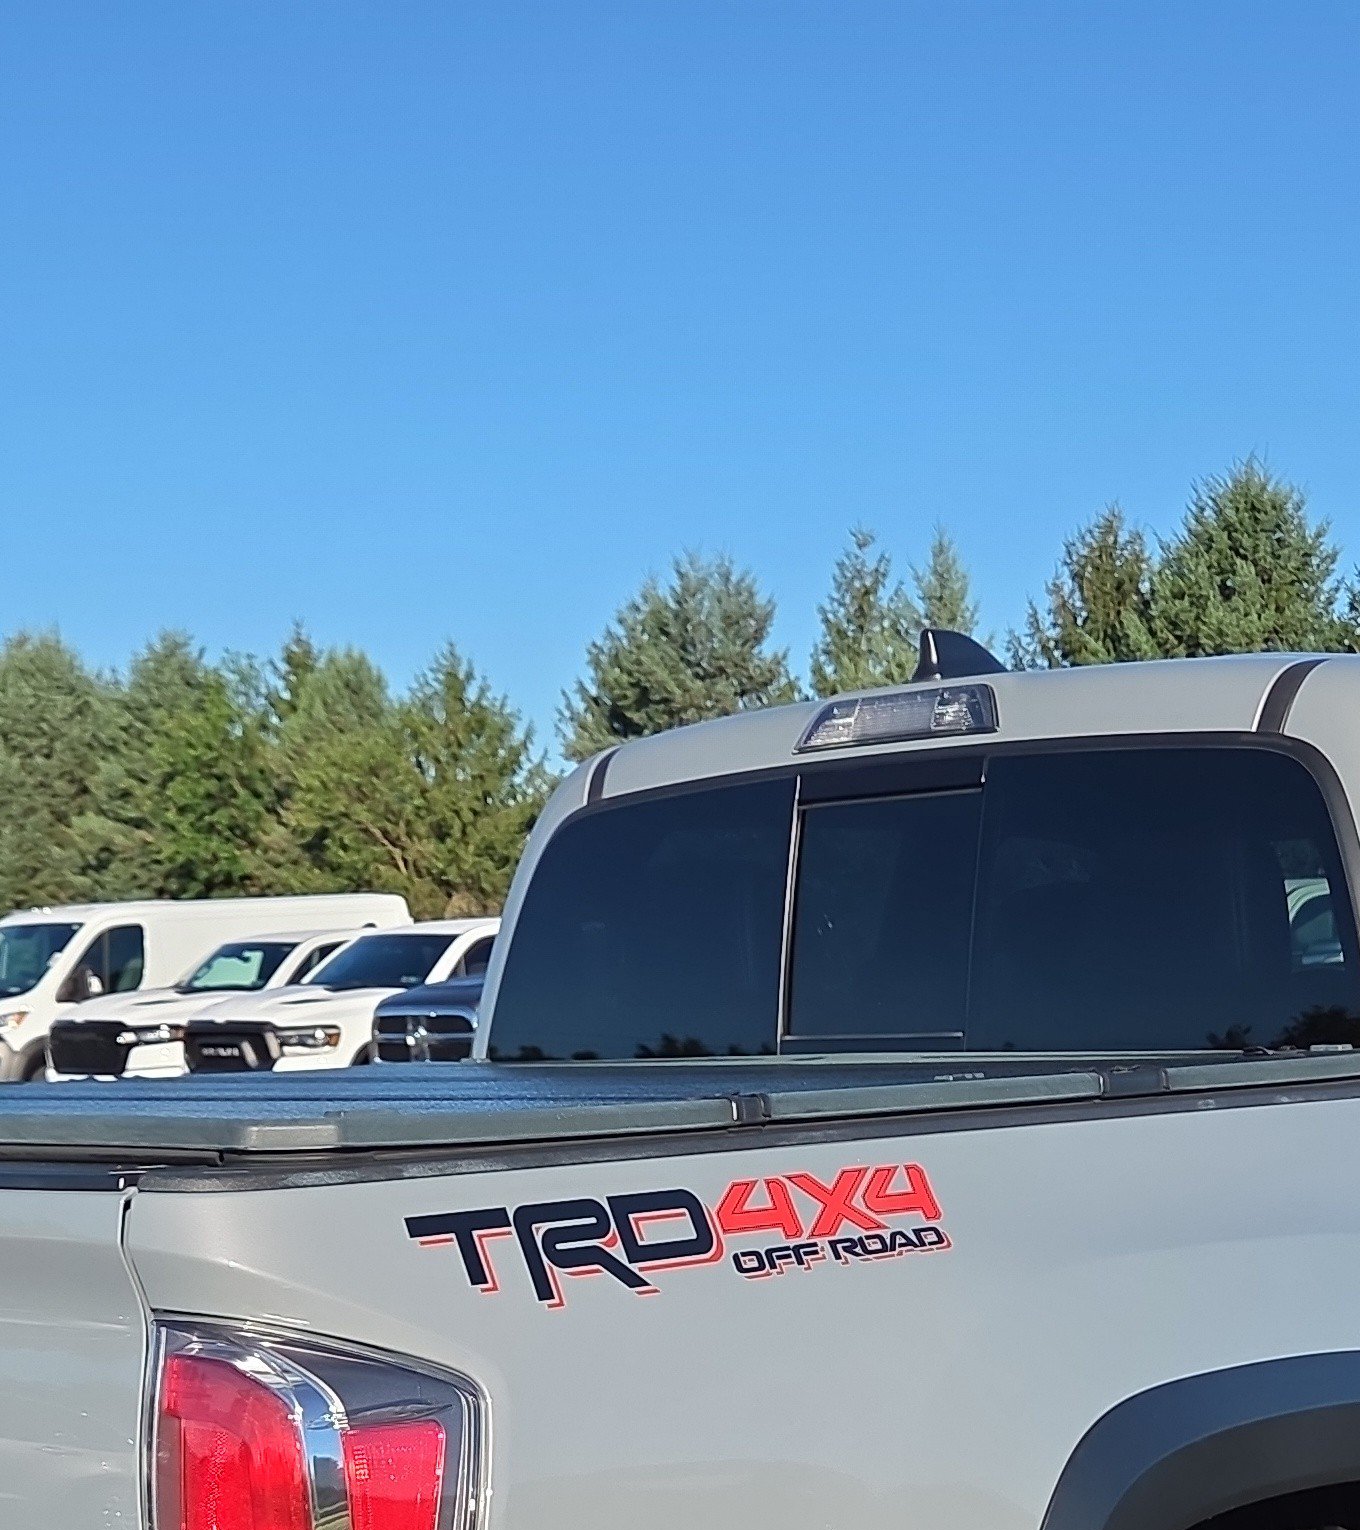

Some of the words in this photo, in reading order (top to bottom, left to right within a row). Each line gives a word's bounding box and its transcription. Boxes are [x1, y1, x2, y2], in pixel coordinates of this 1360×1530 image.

[402, 1187, 725, 1310] TRD
[715, 1163, 942, 1240] 4X4
[732, 1239, 824, 1280] OFF
[826, 1225, 954, 1266] ROAD
